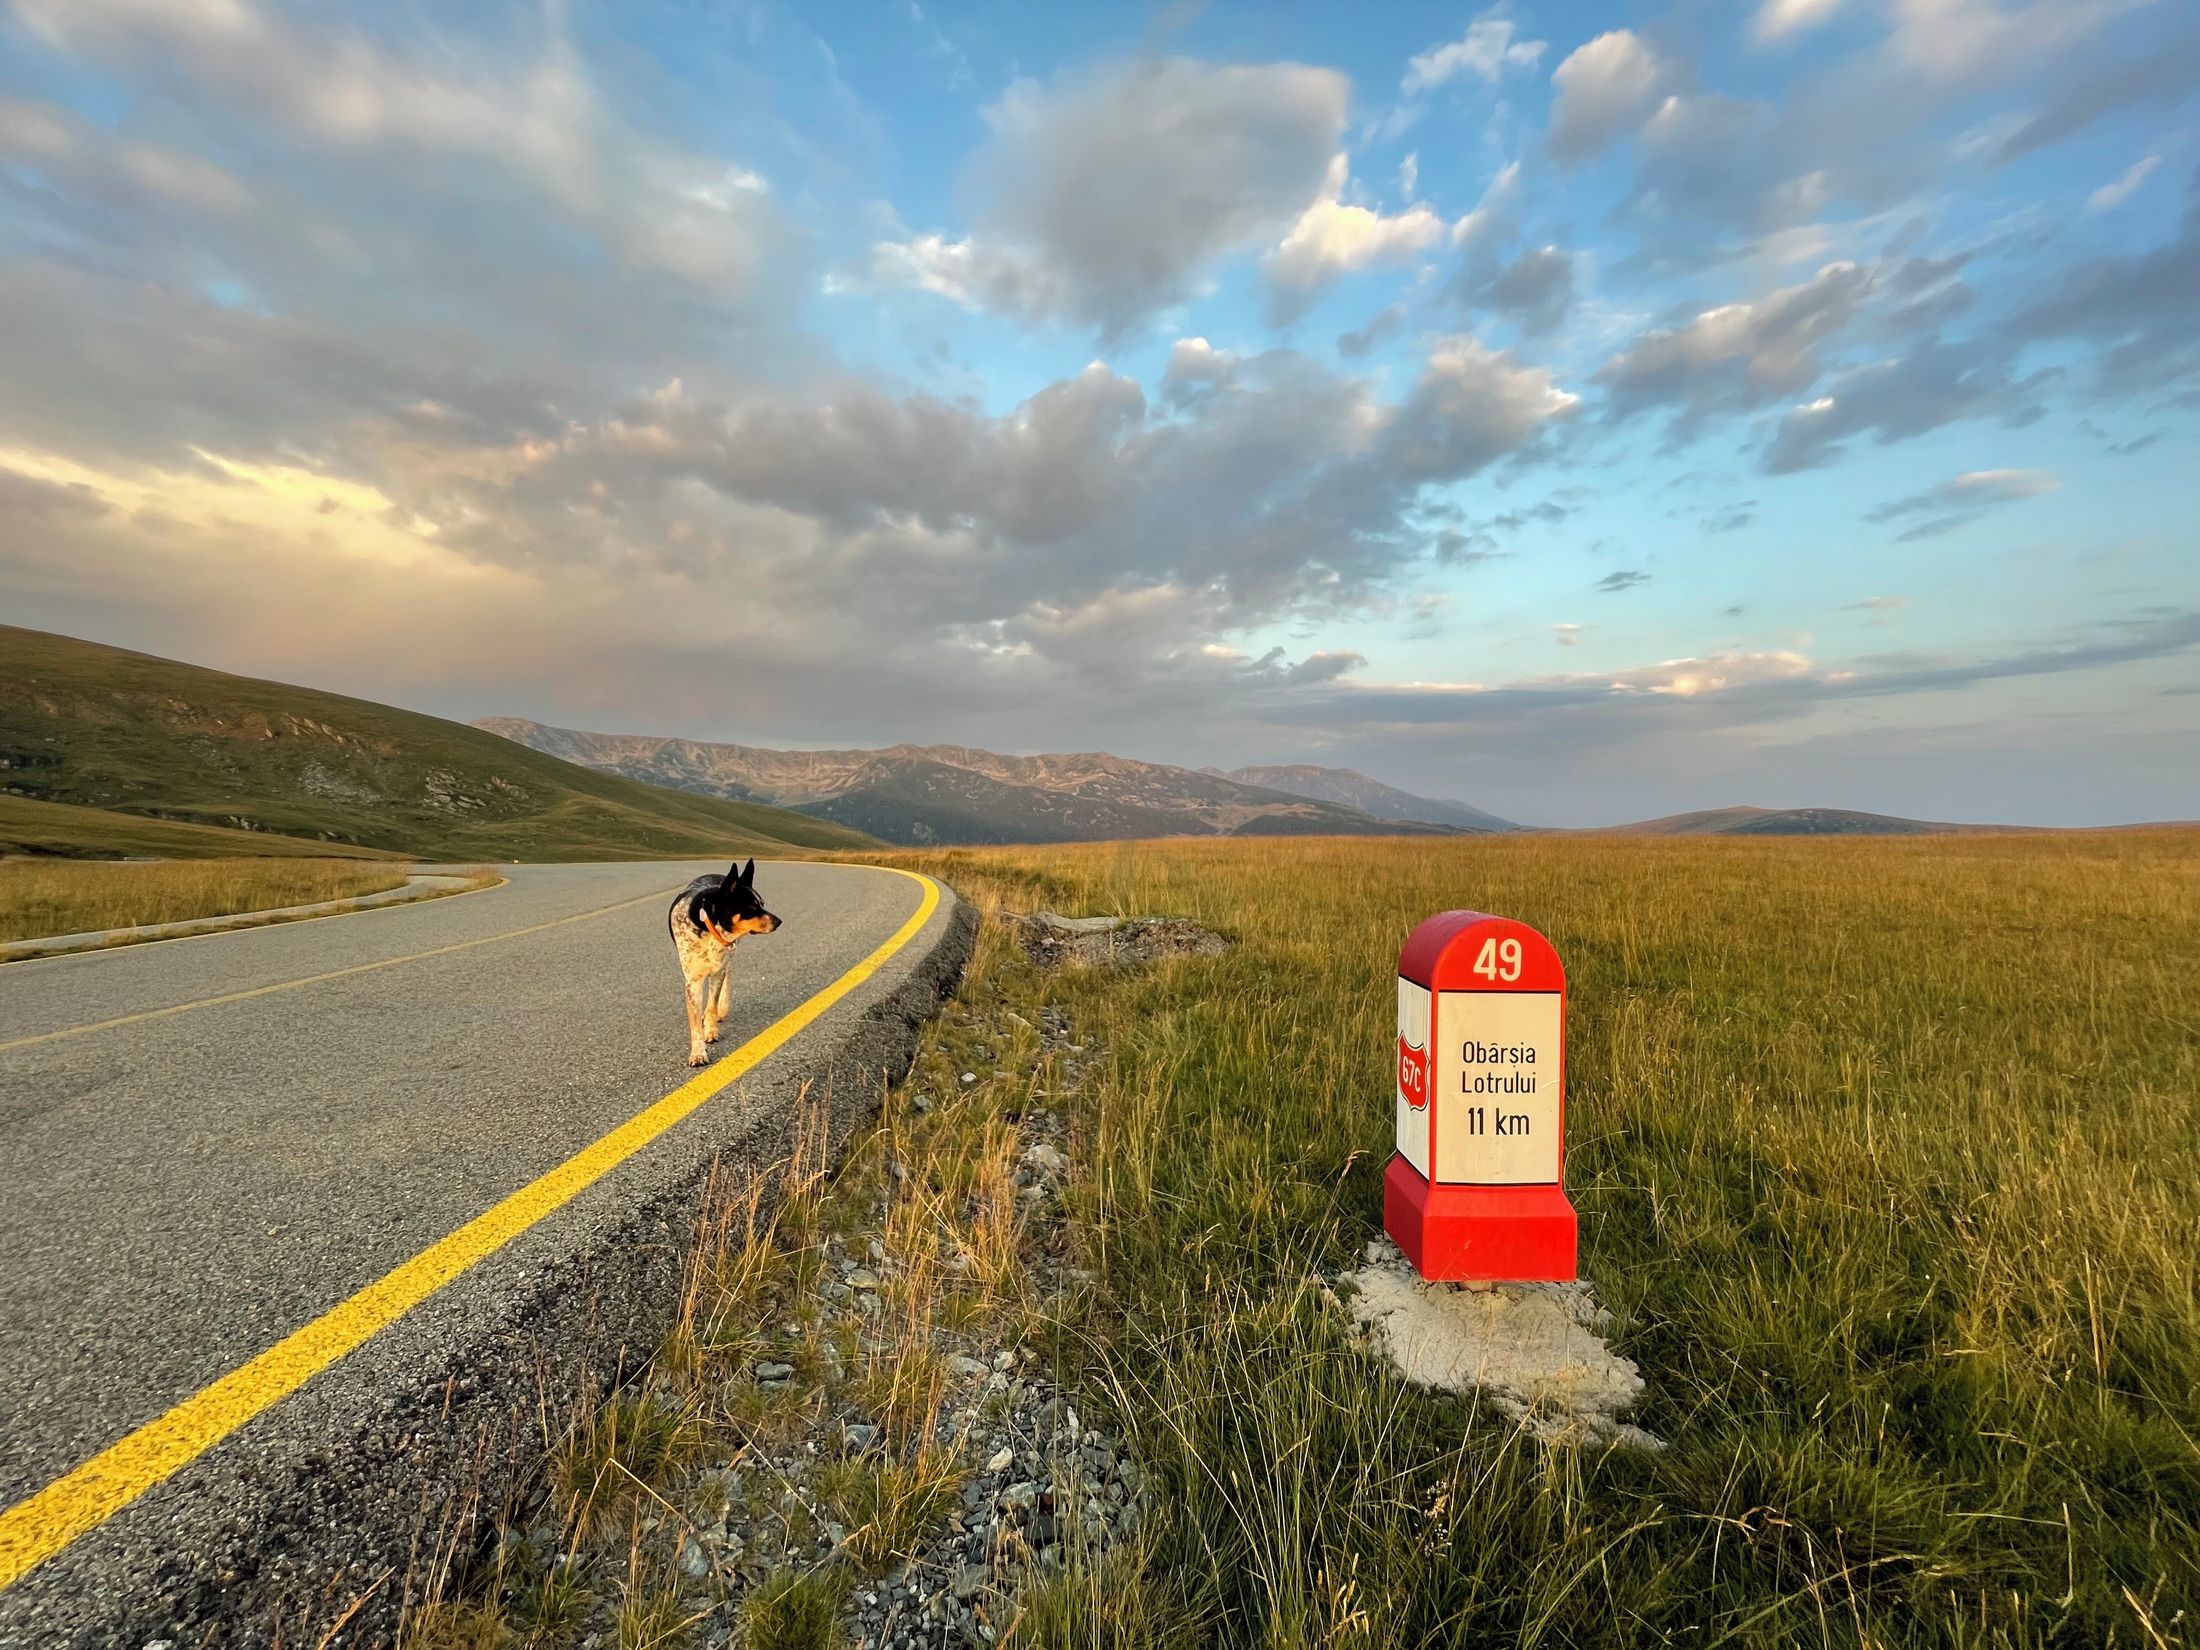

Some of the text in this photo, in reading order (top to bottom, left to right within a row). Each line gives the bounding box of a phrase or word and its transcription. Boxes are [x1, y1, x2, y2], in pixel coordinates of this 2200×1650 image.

[1473, 938, 1522, 982] 49
[1402, 1055, 1421, 1093] 67C
[1462, 1071, 1536, 1093] Lotrului
[1468, 1107, 1530, 1135] 11 km
